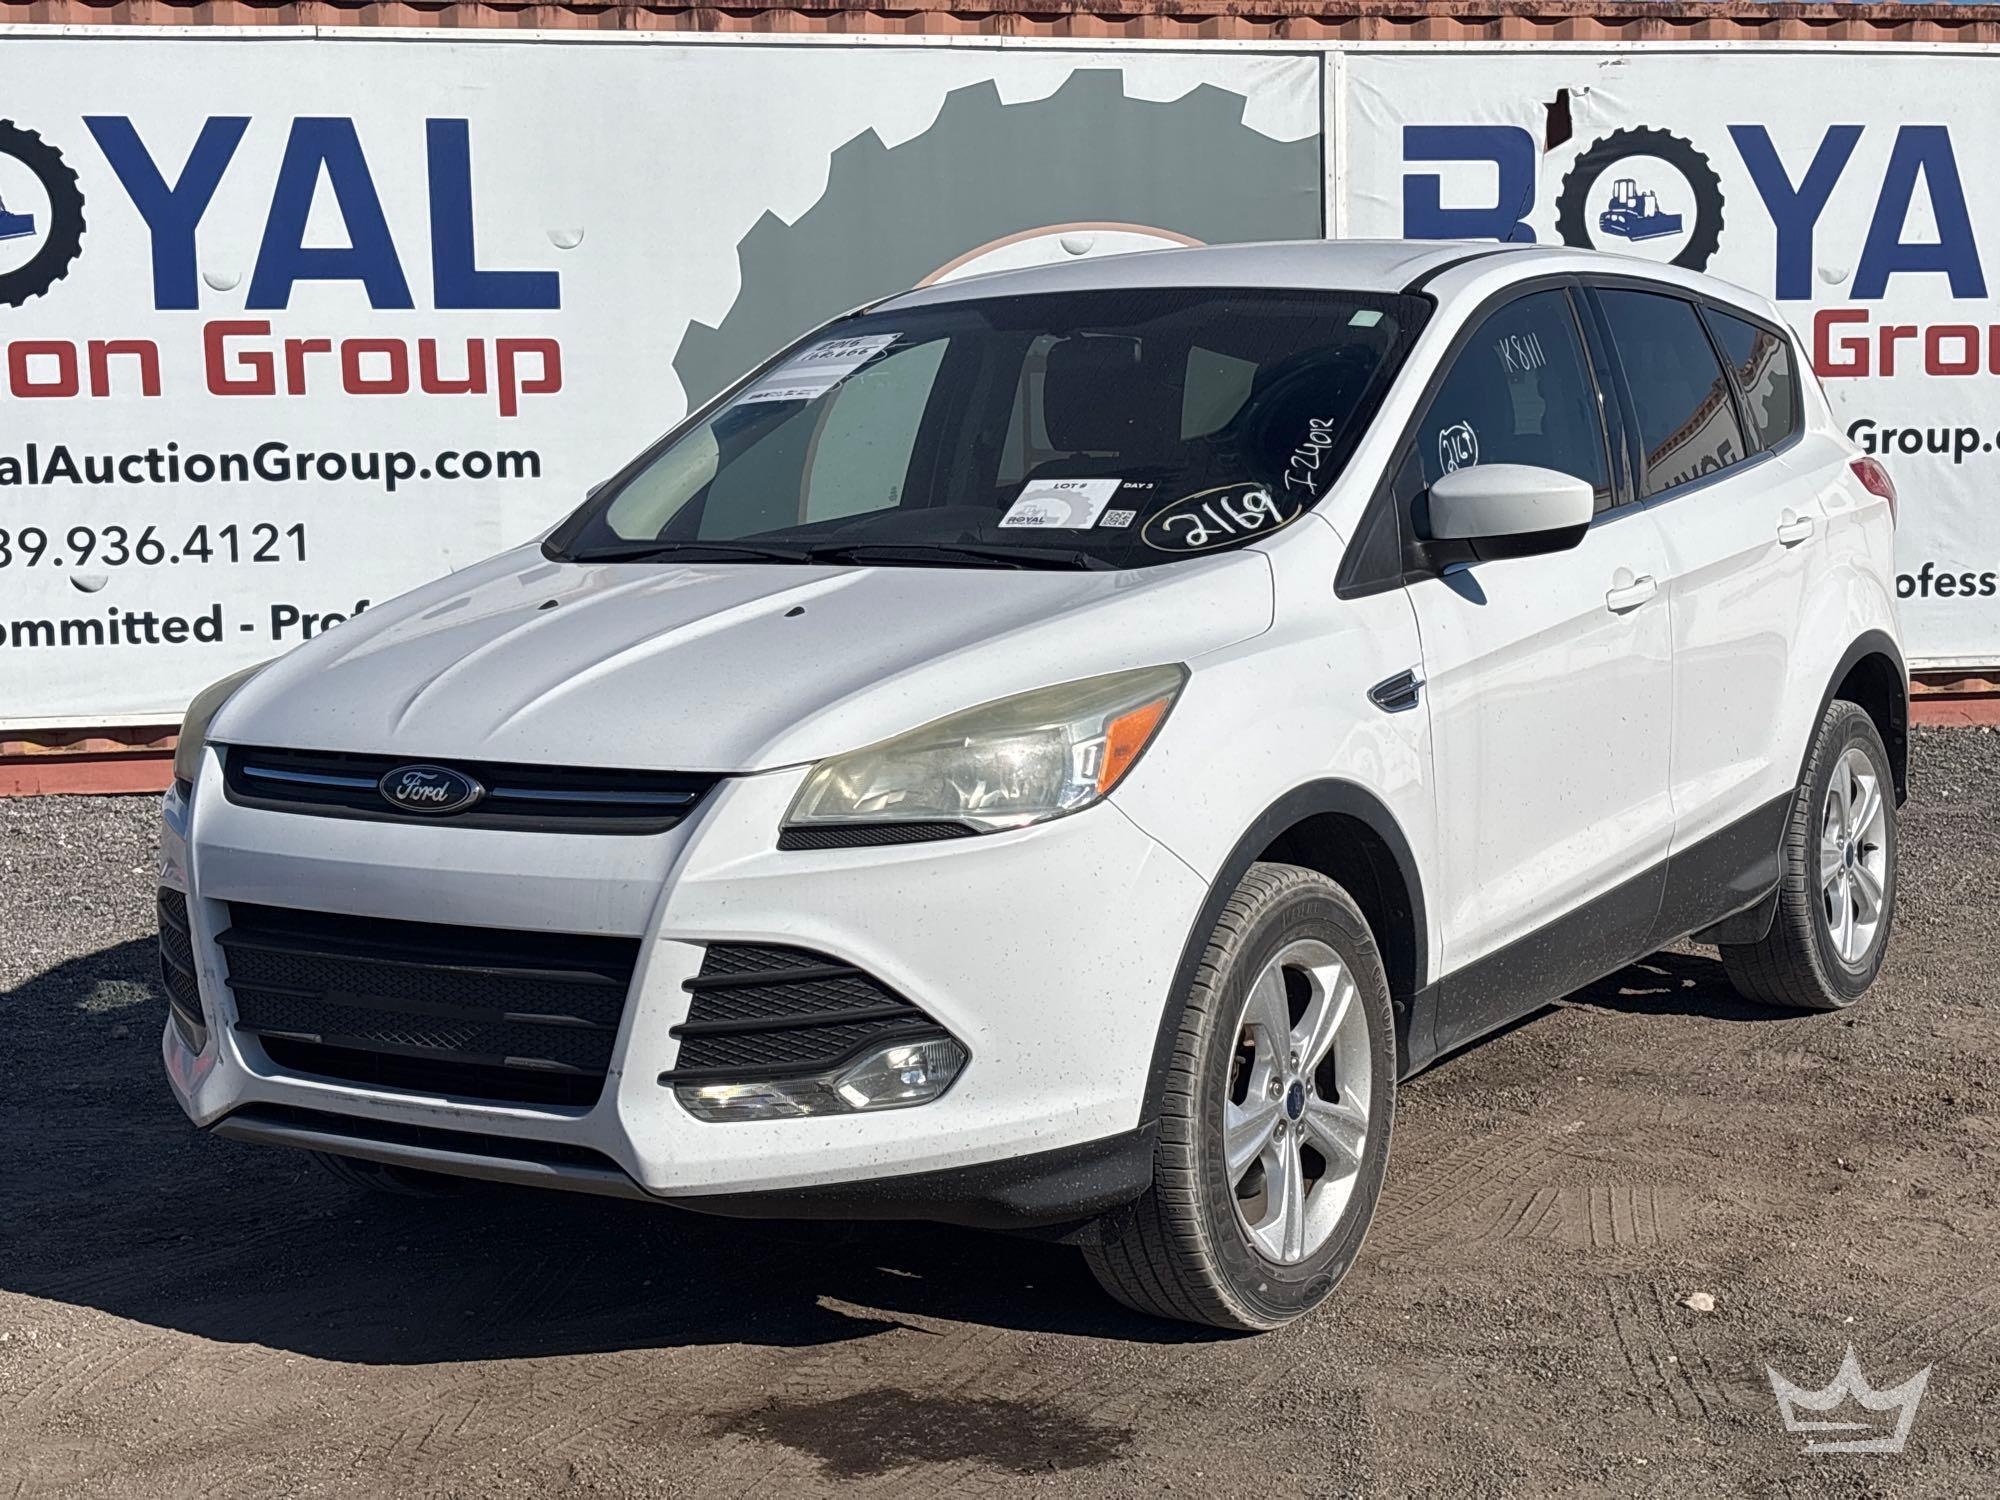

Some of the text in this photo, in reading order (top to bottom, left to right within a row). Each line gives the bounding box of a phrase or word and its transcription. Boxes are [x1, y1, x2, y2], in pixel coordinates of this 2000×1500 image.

[1813, 308, 2000, 377] Gro
[203, 320, 562, 417] Group
[1847, 419, 2000, 464] Group.
[1006, 516, 1045, 524] ROYAL
[1162, 489, 1285, 546] 2169
[0, 604, 223, 647] mmitted
[396, 771, 450, 802] Ford
